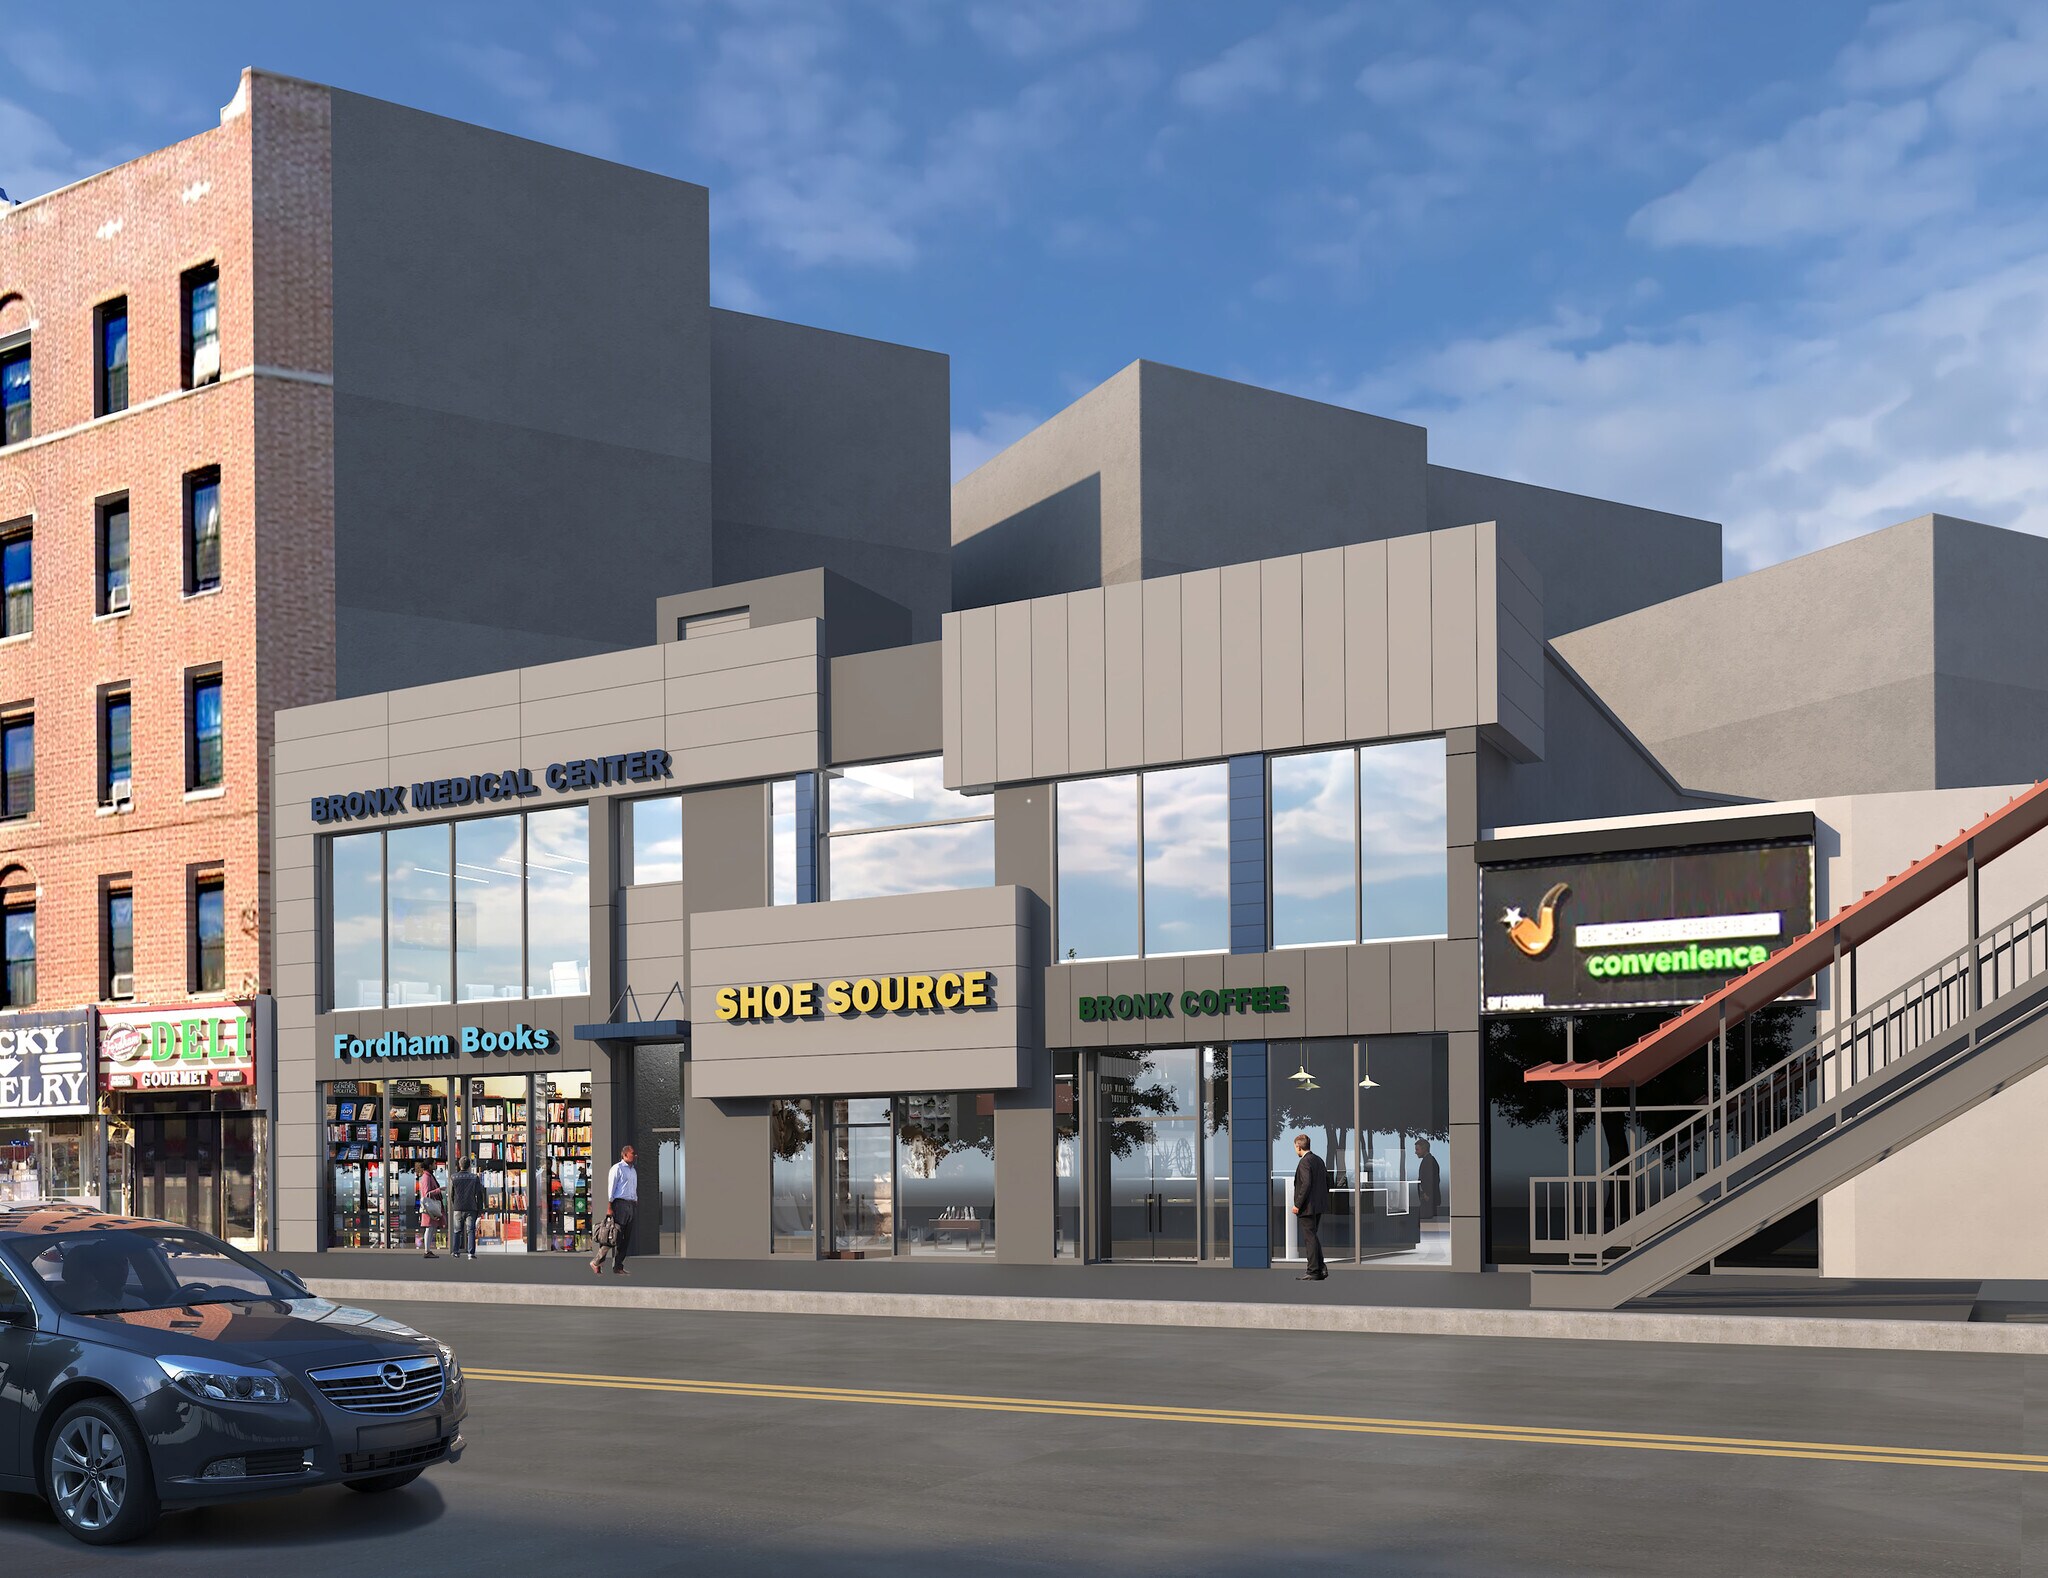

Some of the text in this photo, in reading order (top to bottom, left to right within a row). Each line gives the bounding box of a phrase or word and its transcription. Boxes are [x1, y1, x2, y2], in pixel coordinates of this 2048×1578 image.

[311, 749, 671, 822] BRONX MEDICAL CENTER
[1588, 944, 1767, 977] convenience
[714, 970, 989, 1020] SHOE SOURCE
[1078, 985, 1289, 1020] BRONX COFFEE
[150, 1015, 248, 1062] DELI
[334, 1023, 550, 1059] Fordham Books
[141, 1069, 209, 1087] GOURMET
